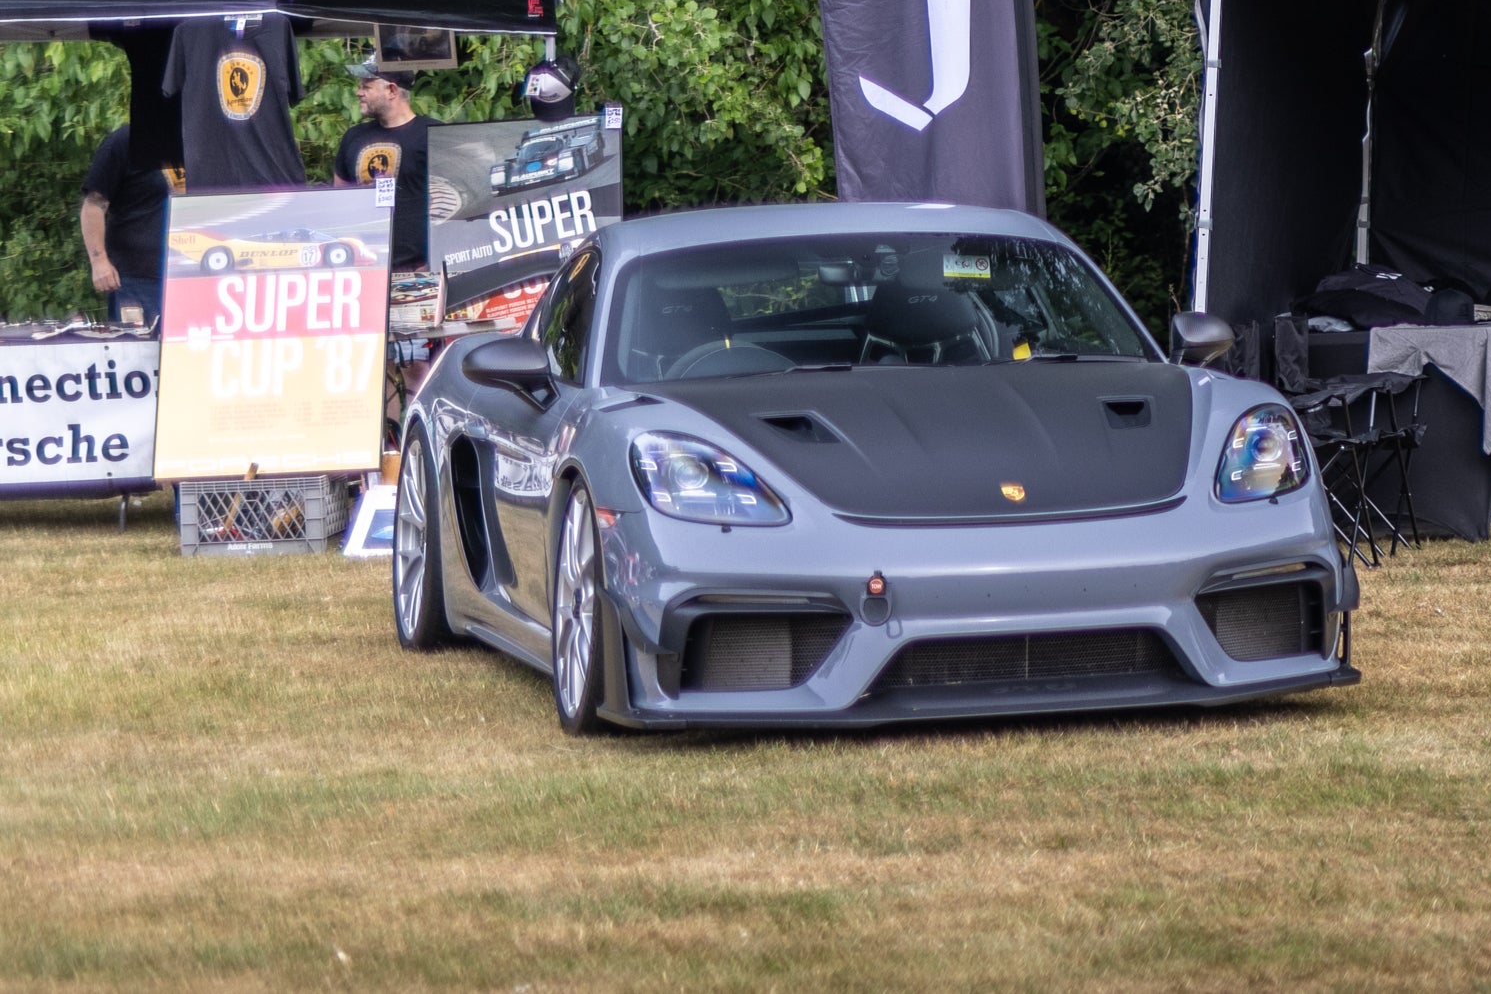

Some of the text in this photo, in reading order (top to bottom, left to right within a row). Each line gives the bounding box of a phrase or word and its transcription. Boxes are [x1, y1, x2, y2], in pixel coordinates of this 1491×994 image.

[489, 190, 597, 254] SUPER
[171, 234, 196, 246] Shell
[239, 248, 315, 264] DUNLOP 17
[444, 244, 493, 266] SPORT AUTO
[215, 271, 362, 334] SUPER
[662, 305, 693, 315] GT4
[908, 294, 938, 305] GT4
[211, 334, 380, 398] CUP '87
[0, 359, 159, 404] nectio
[0, 423, 130, 467] sche
[247, 542, 273, 550] Farms
